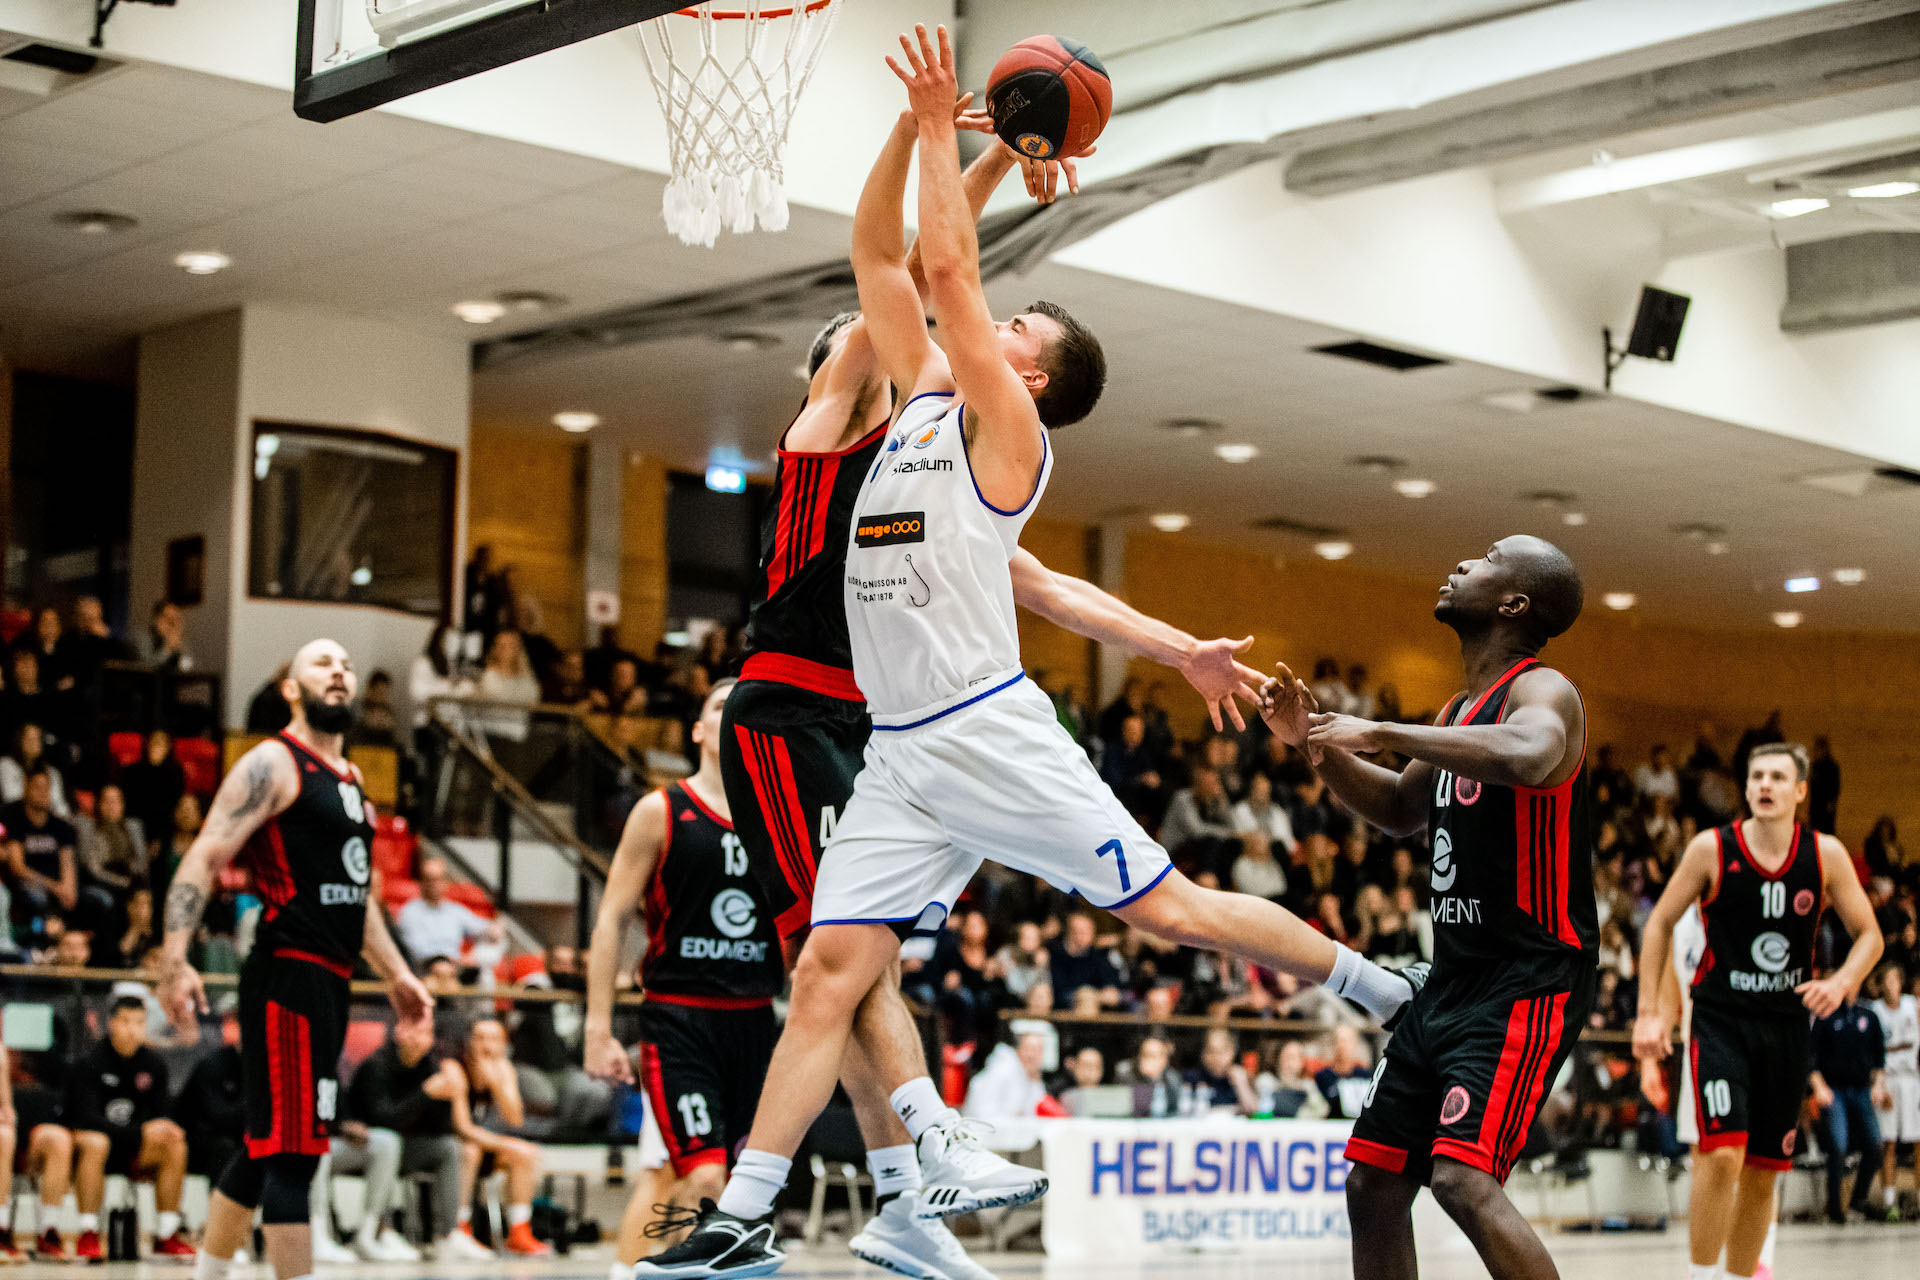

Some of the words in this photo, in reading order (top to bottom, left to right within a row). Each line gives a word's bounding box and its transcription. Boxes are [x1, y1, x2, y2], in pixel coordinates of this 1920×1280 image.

[861, 577, 896, 590] GNUSSON
[720, 831, 749, 877] 13
[1095, 838, 1131, 893] 7
[1760, 880, 1786, 919] 10
[679, 936, 768, 963] EDUMENT
[1729, 967, 1804, 993] EDUMENT
[676, 1092, 713, 1137] 13
[1703, 1078, 1732, 1118] 10
